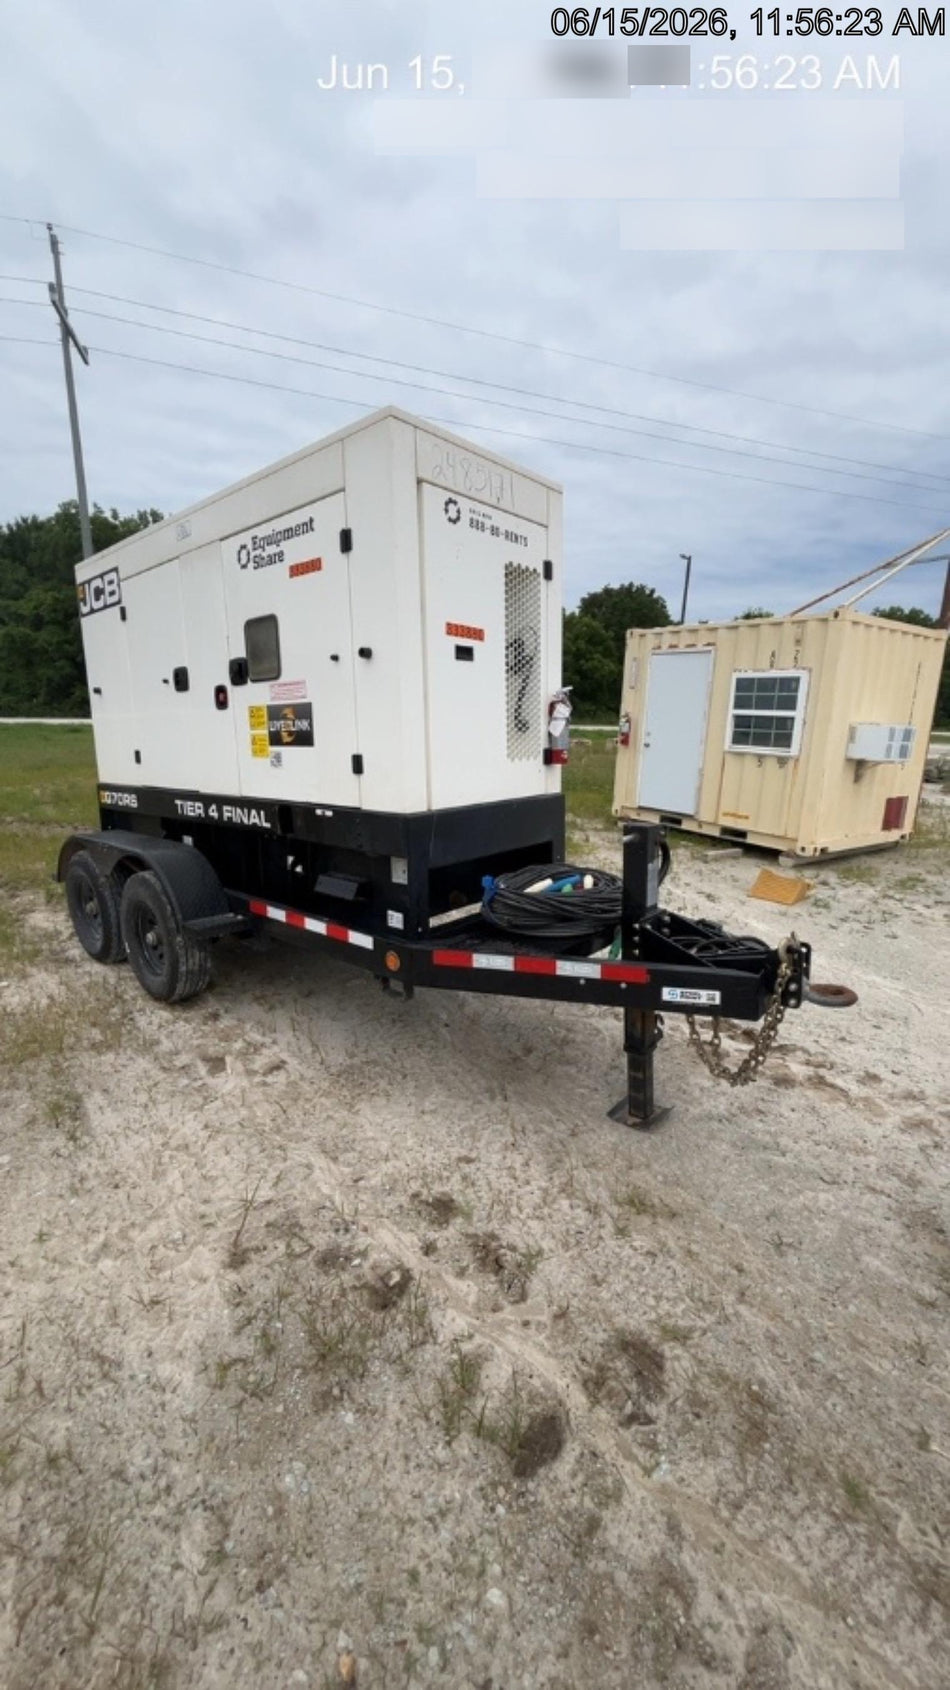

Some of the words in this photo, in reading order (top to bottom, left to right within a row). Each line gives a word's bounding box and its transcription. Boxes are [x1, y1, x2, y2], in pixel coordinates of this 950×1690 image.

[251, 516, 315, 552] Equipment
[252, 550, 285, 570] Share
[78, 570, 120, 616] JCB
[174, 799, 205, 818] TIER
[208, 803, 218, 820] 4
[222, 805, 271, 828] FINAL
